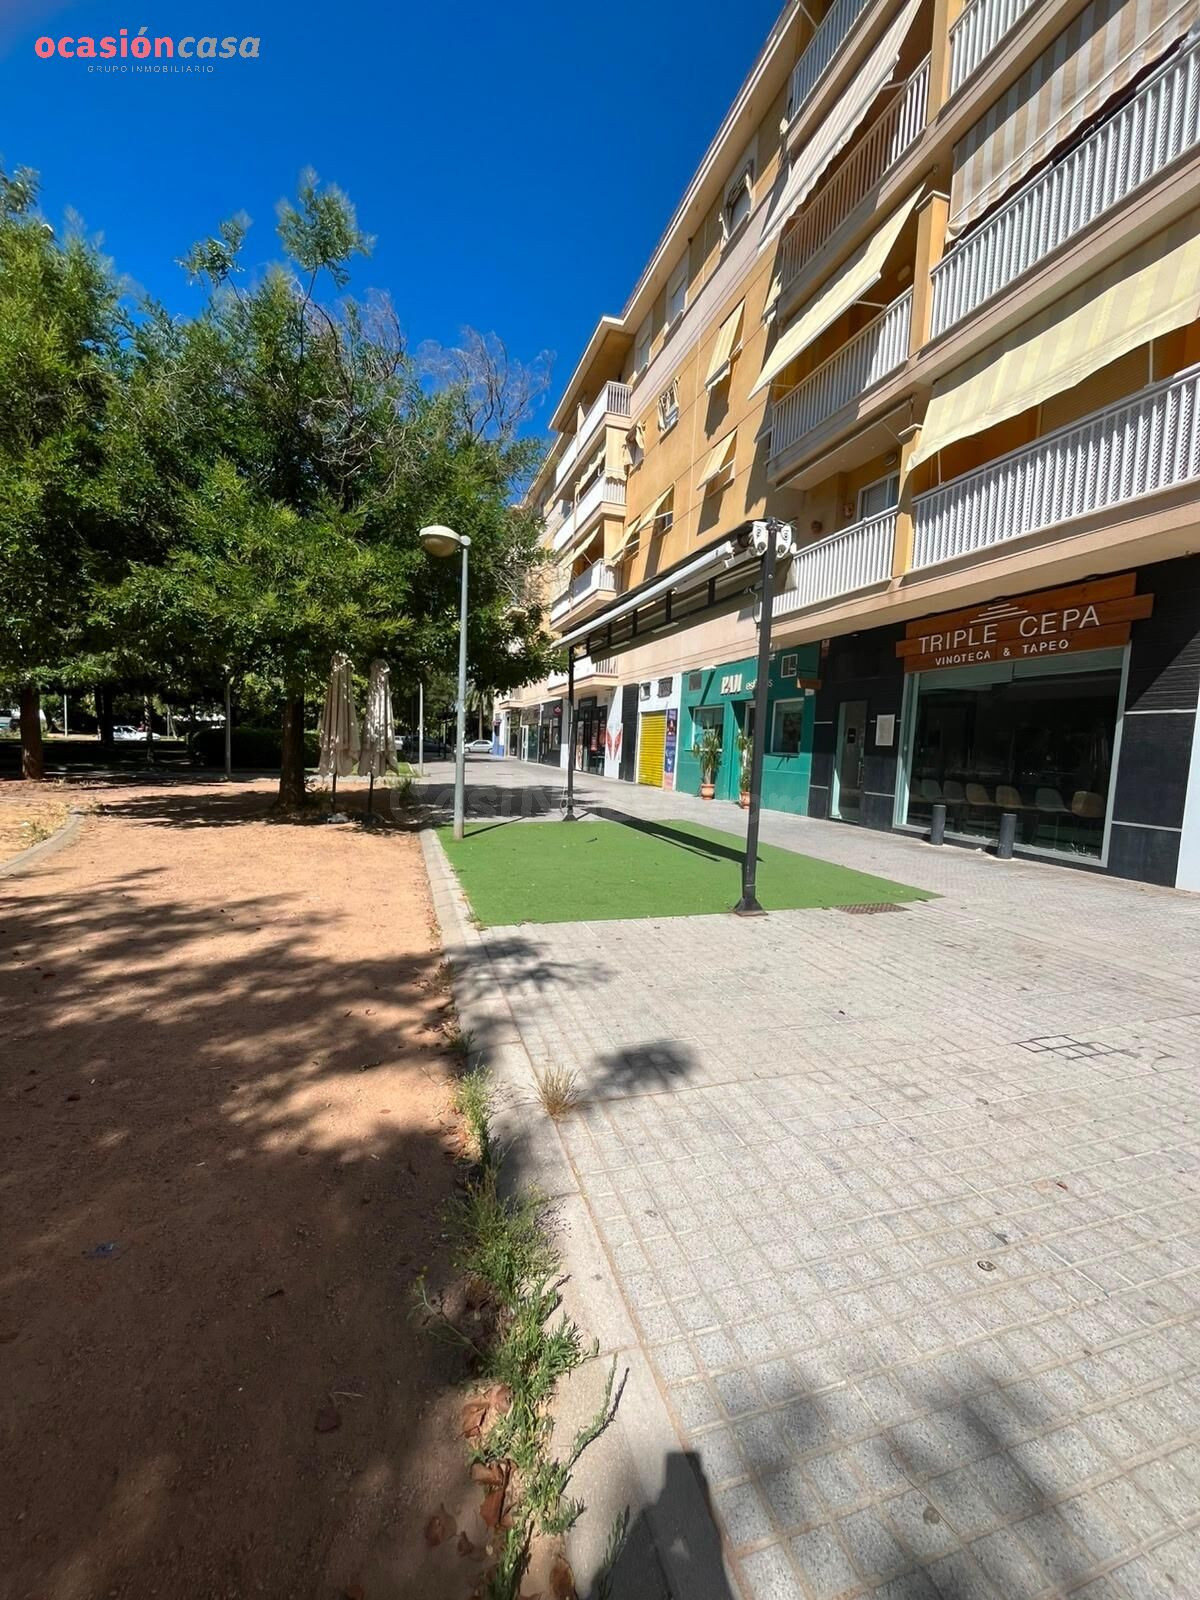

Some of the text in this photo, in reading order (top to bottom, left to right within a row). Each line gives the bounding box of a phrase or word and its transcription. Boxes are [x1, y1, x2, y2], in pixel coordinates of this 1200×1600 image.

[918, 605, 1101, 654] TRIPLE CEPA
[935, 639, 1069, 666] VINOTECA & TAPEO
